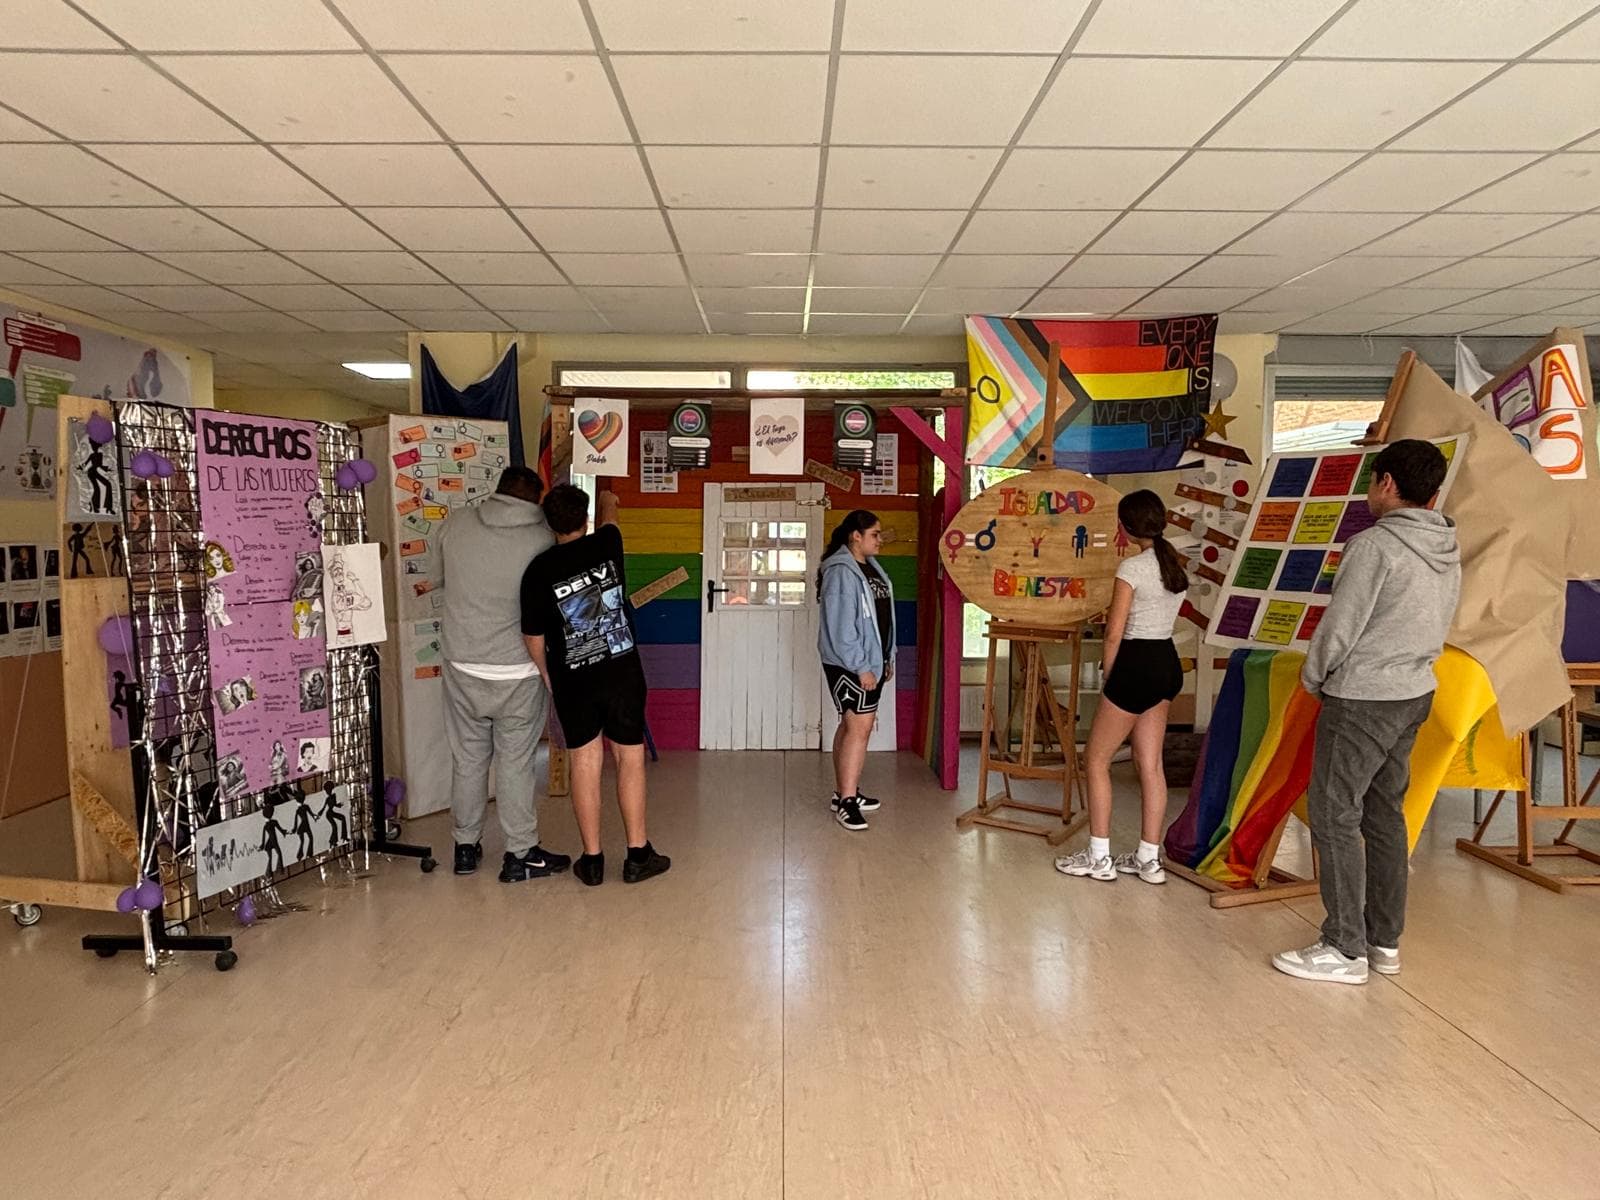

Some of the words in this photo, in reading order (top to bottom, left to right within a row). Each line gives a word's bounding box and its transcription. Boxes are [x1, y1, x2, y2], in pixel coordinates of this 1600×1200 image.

[1141, 318, 1213, 346] EVERY
[1166, 340, 1211, 370] ONE
[1188, 366, 1210, 393] IS
[202, 418, 312, 461] DERECHOS
[1149, 416, 1202, 449] HER
[207, 465, 233, 492] DE
[235, 467, 259, 492] LAS
[260, 467, 318, 493] MUJERES
[999, 487, 1096, 516] IGUALDAD
[1030, 529, 1047, 558] Y
[993, 569, 1087, 599] BIENESTAR
